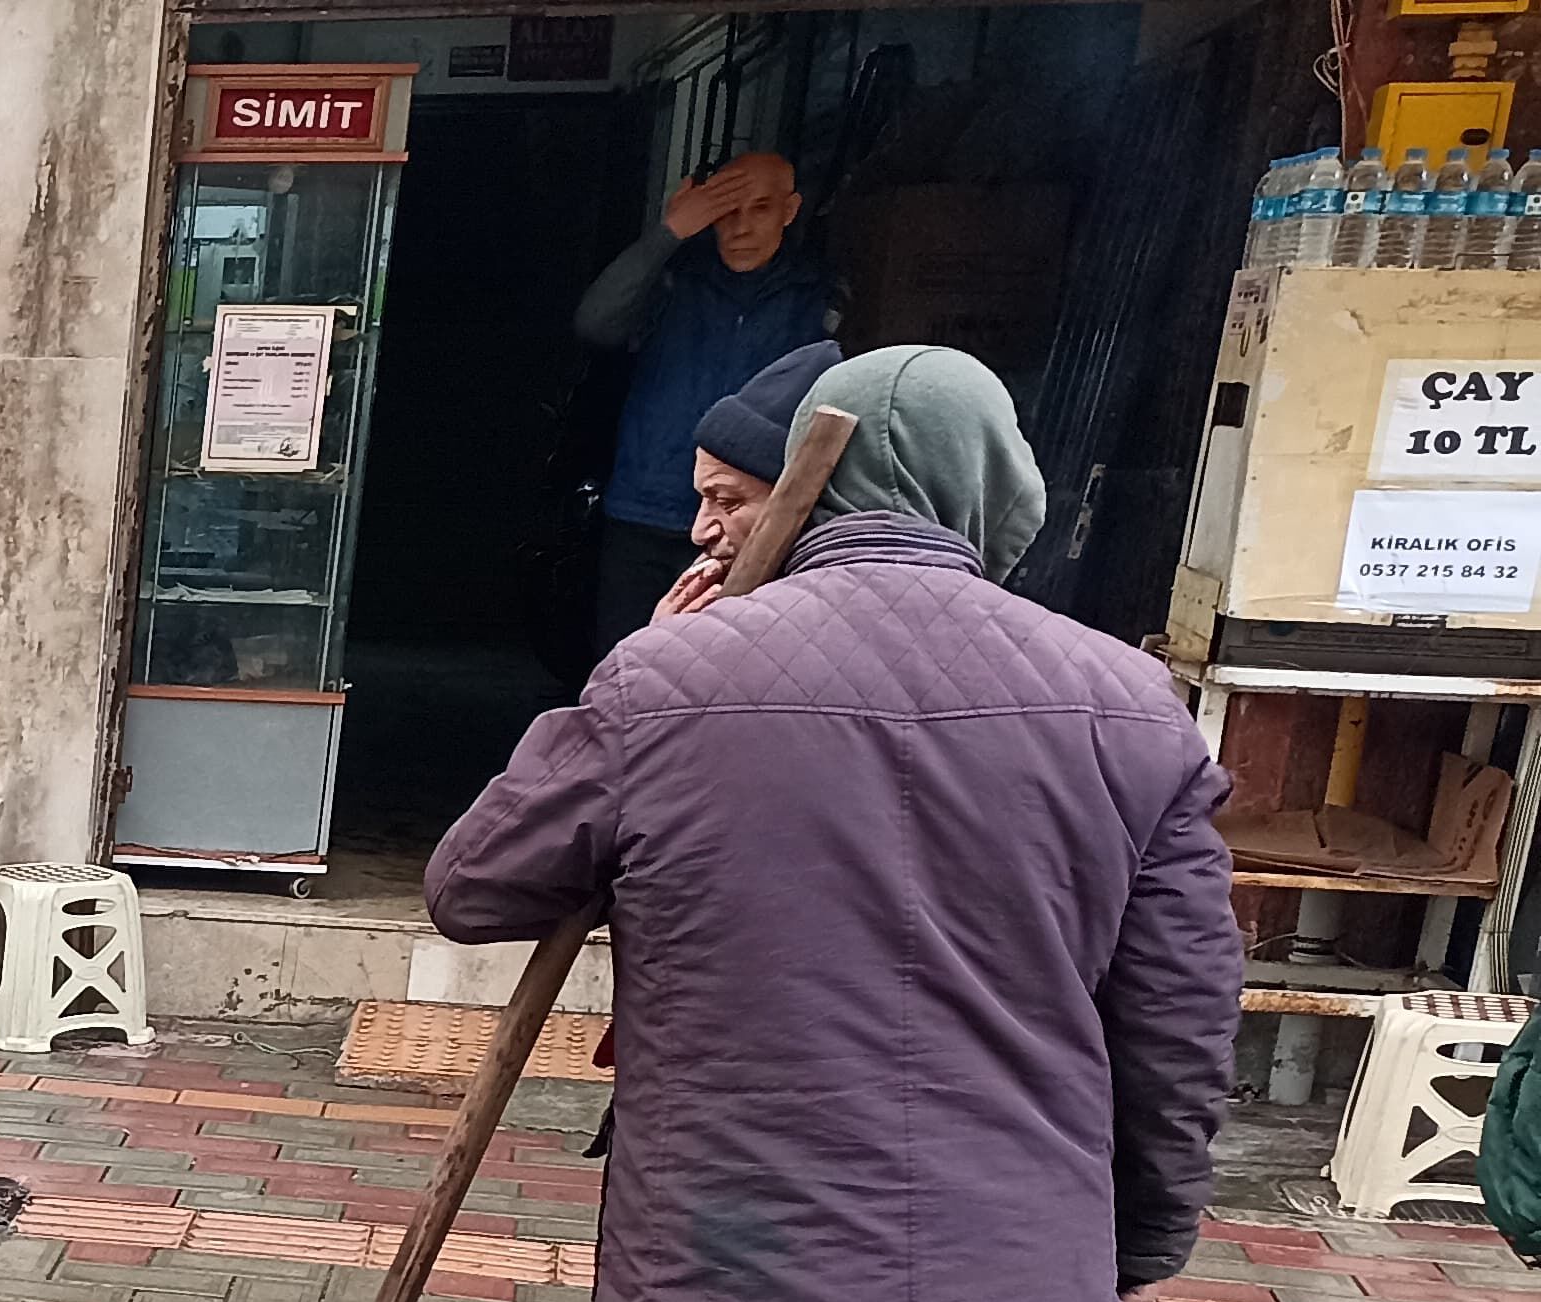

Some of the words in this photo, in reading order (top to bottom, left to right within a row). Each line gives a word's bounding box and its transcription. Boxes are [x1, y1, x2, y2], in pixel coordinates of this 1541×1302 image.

[232, 92, 363, 129] SİMİT
[1422, 371, 1534, 409] ÇAY
[1406, 430, 1462, 454] 10
[1474, 426, 1537, 455] TL
[1370, 534, 1459, 551] KİRALIK
[1466, 536, 1517, 552] OFİS
[1359, 563, 1409, 577] 0537
[1416, 564, 1454, 578] 215
[1460, 565, 1486, 578] 84
[1493, 565, 1518, 579] 32
